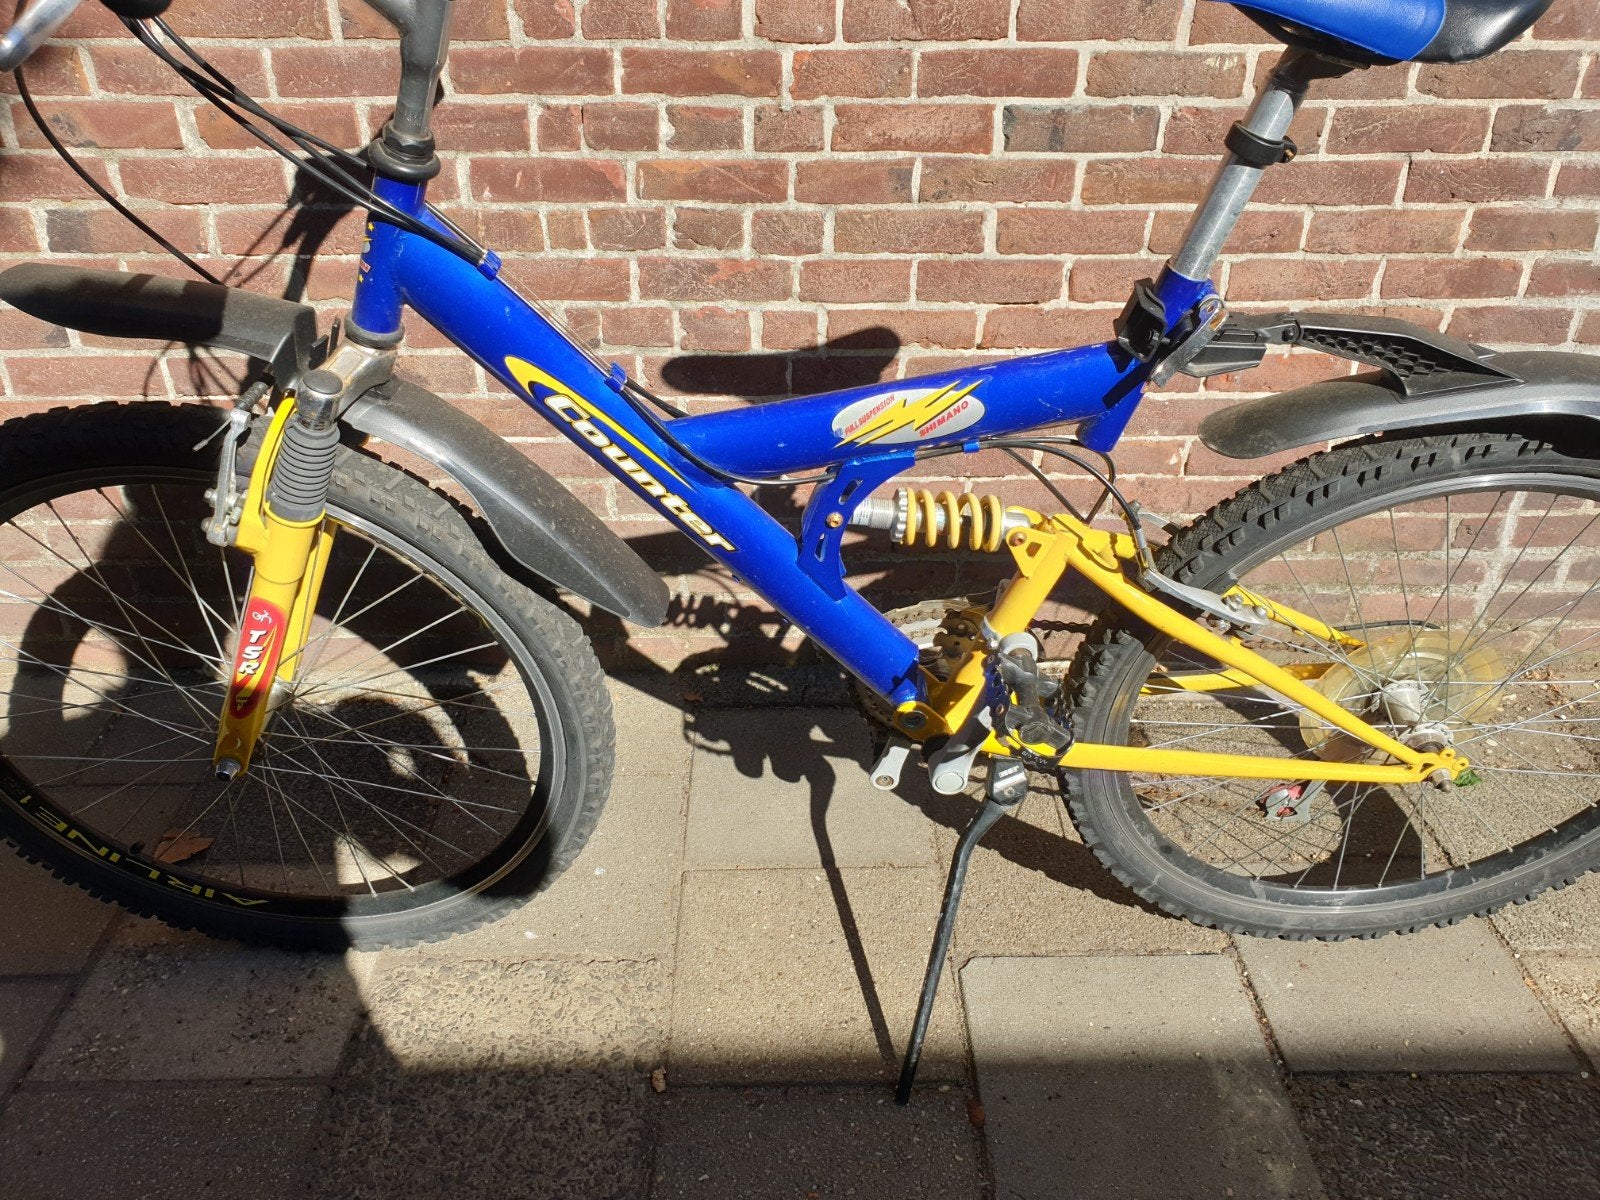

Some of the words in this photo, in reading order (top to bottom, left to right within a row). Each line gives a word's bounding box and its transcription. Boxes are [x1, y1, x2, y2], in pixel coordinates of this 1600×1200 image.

[844, 421, 860, 436] FULL
[858, 394, 895, 425] SUSPENSION
[919, 400, 969, 438] SHIMANO
[544, 394, 736, 551] Counter
[238, 629, 267, 675] TSR
[35, 806, 268, 906] AIRLINE
